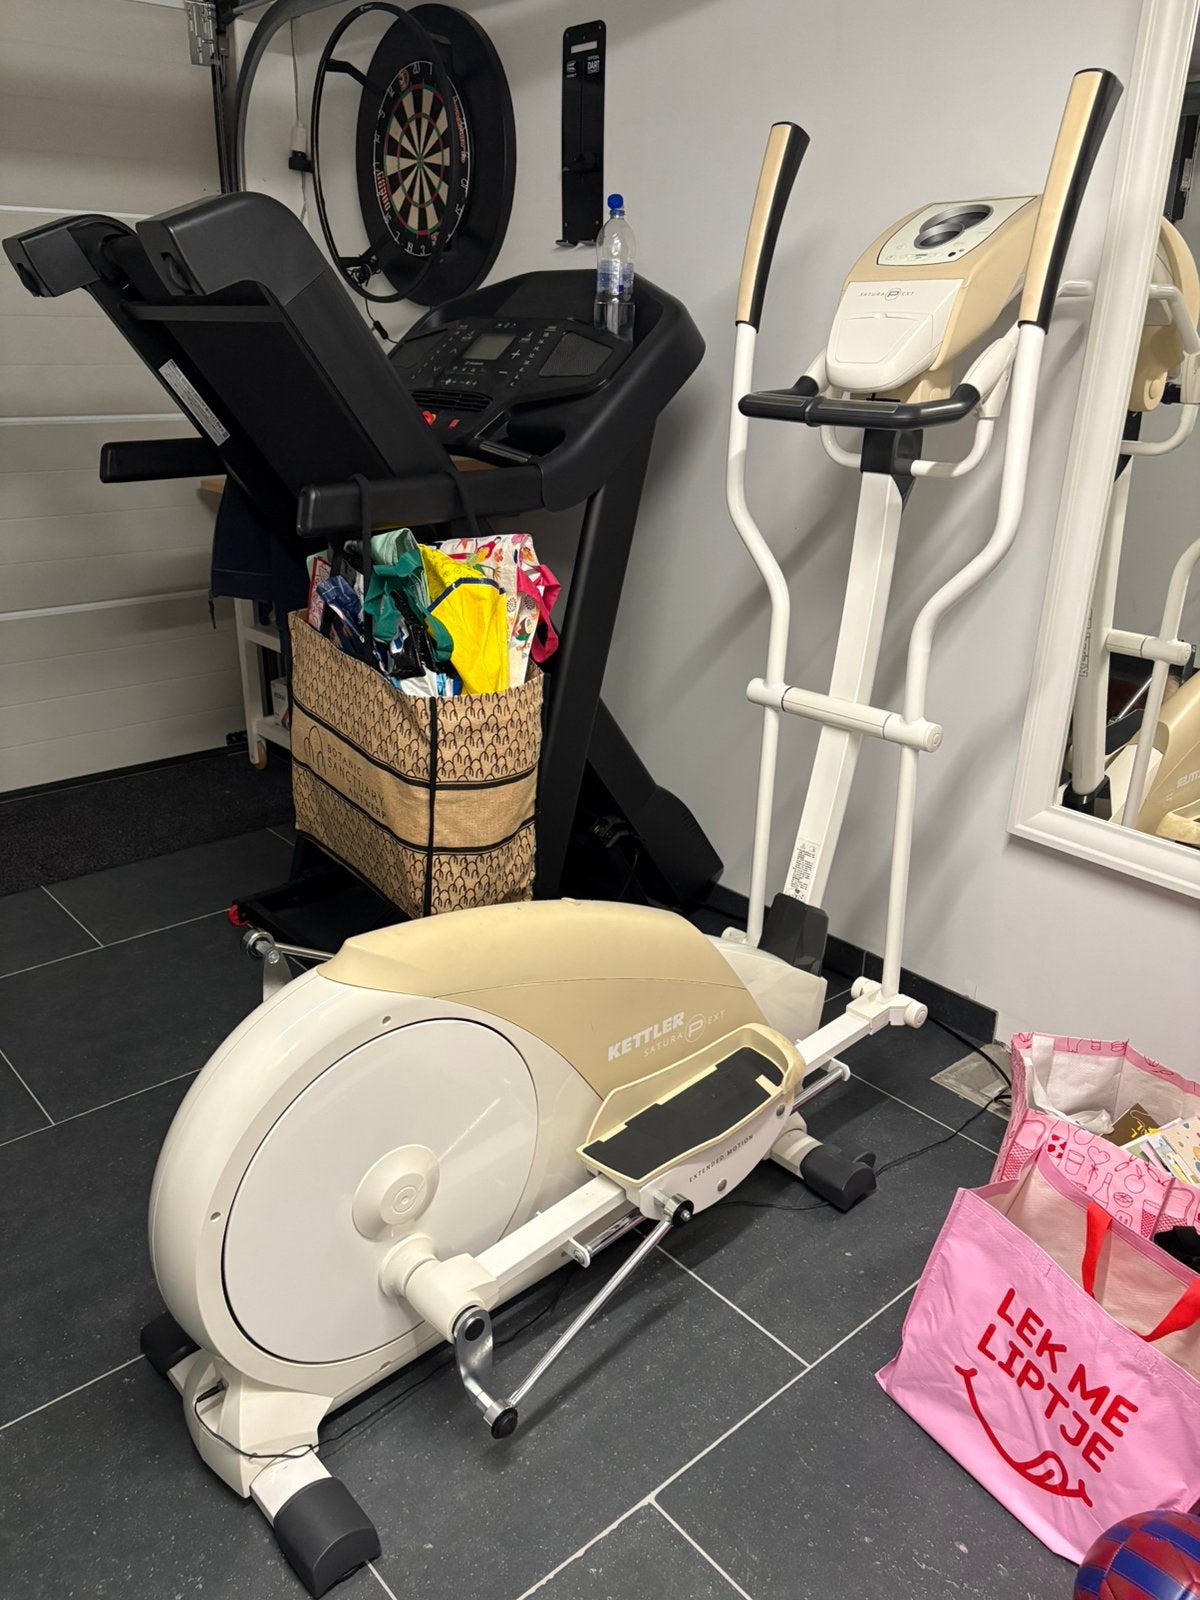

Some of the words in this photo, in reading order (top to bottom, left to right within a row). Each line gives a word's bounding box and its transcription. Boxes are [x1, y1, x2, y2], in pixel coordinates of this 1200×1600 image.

[327, 744, 362, 777] BOTANIC
[327, 757, 384, 807] SANCTUARY
[607, 1011, 685, 1062] KETTLER
[643, 1031, 683, 1058] SATURA
[707, 1009, 726, 1025] EXT
[689, 1154, 725, 1183] EXTENDED
[726, 1134, 754, 1156] MOTION
[997, 1287, 1068, 1374] LEK
[1066, 1363, 1138, 1438] ME
[977, 1323, 1115, 1473] LIPTJE
